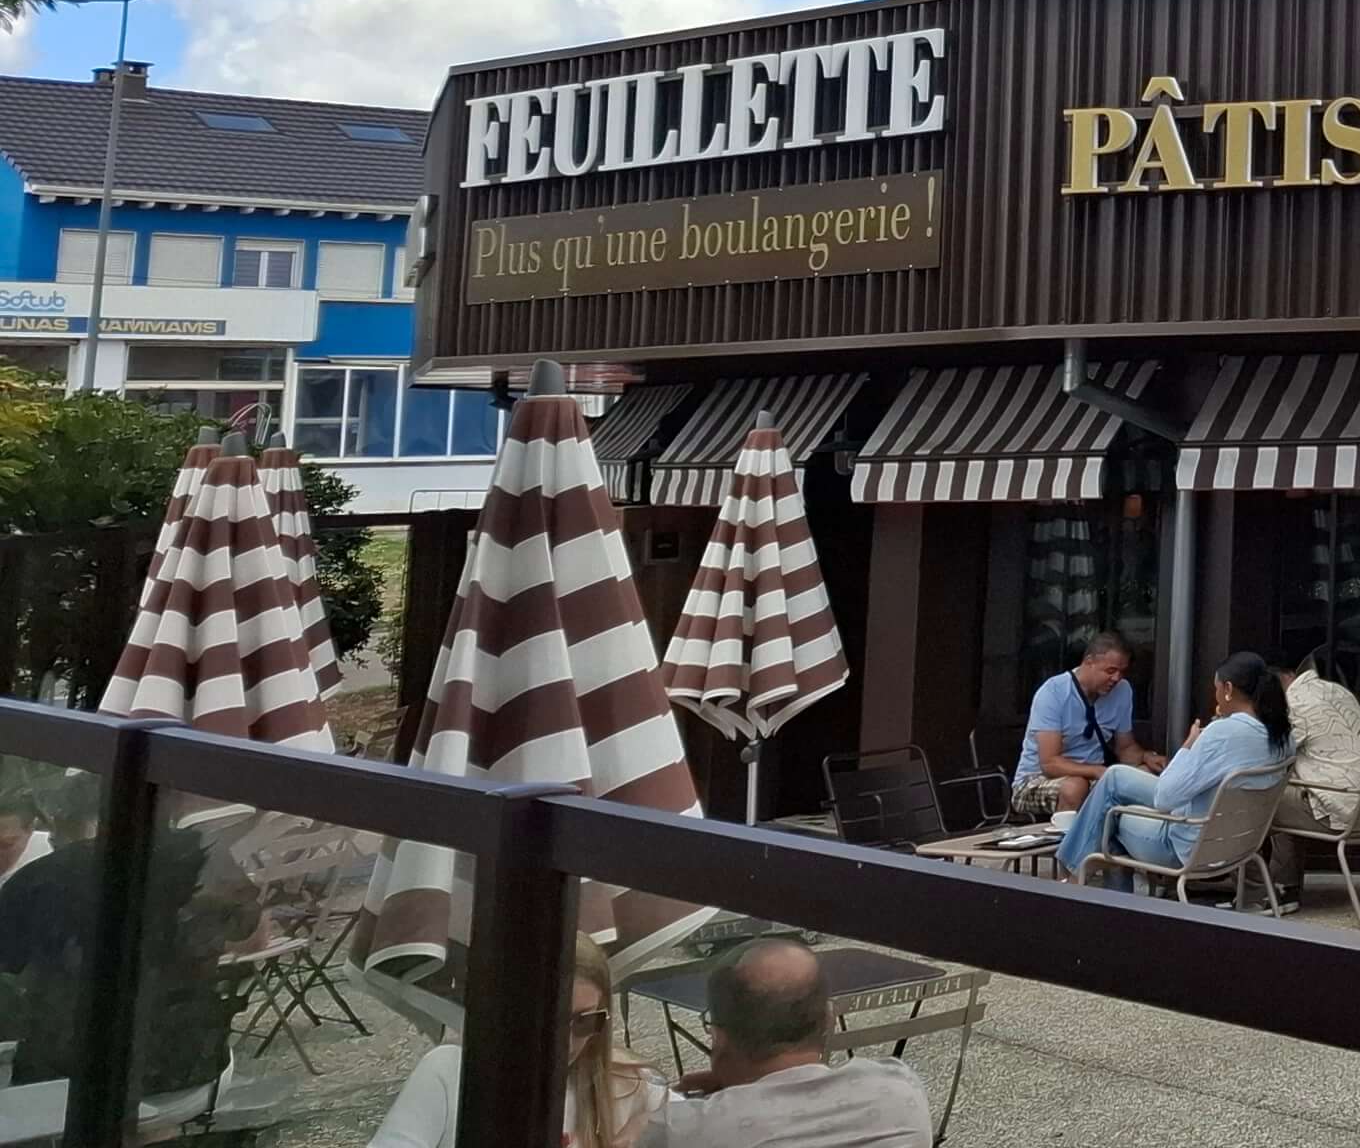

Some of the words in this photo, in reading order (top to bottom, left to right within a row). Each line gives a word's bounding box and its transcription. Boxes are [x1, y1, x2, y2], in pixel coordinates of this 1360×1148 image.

[460, 28, 945, 189] FEUILLETTE
[472, 223, 541, 278] Plus
[552, 214, 667, 292] qu'une
[0, 290, 65, 308] Softub
